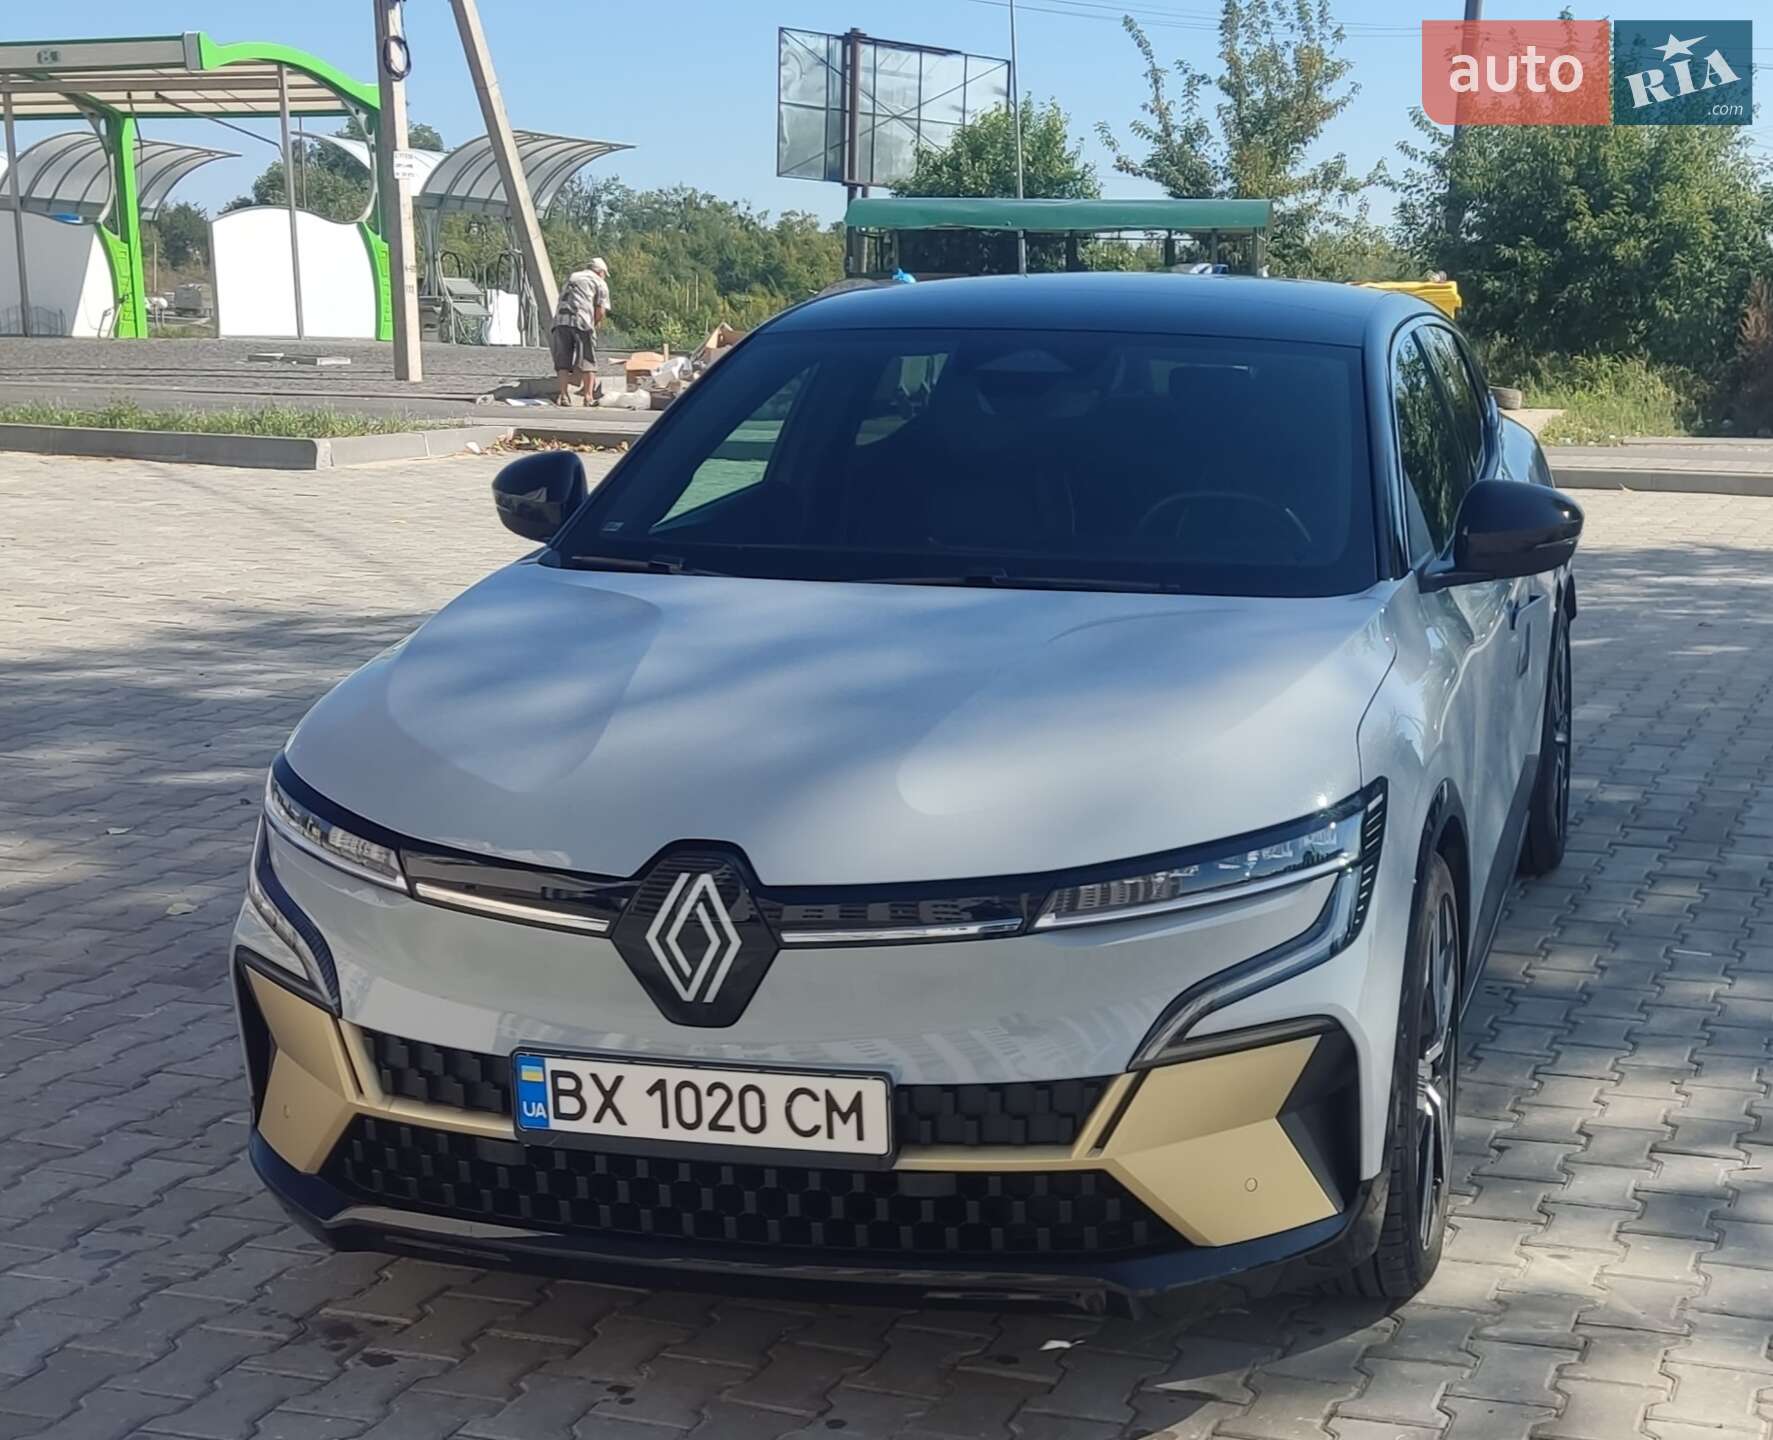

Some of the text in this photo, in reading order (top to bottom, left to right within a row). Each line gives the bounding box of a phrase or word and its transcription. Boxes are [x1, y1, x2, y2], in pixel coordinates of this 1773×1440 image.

[523, 1101, 548, 1119] UA
[550, 1069, 865, 1141] BX 1020 CM
